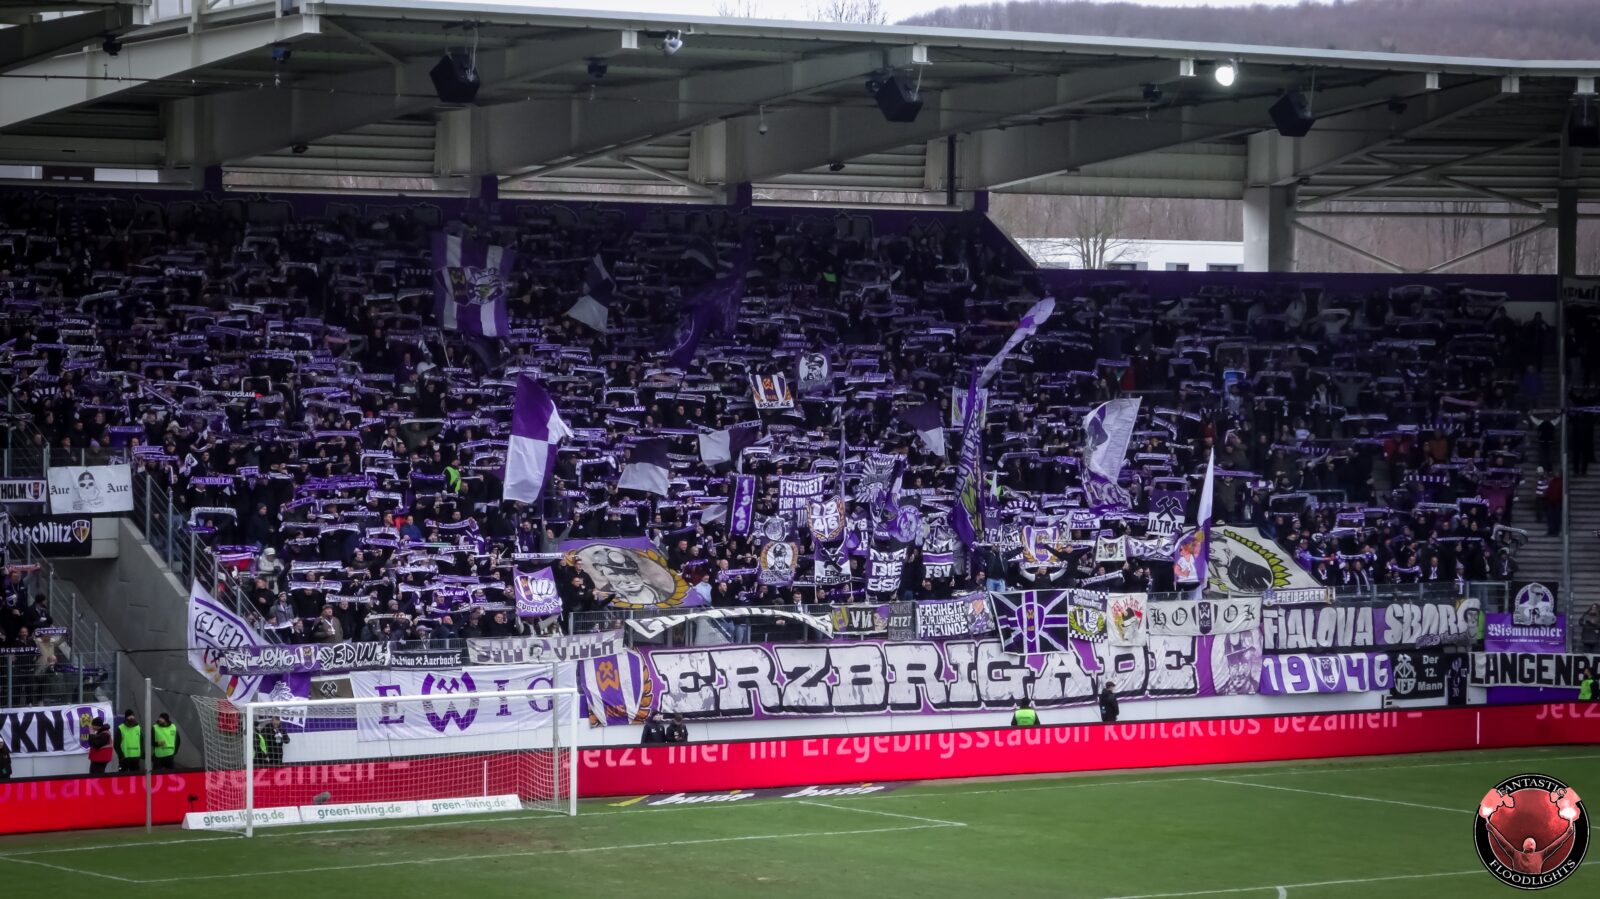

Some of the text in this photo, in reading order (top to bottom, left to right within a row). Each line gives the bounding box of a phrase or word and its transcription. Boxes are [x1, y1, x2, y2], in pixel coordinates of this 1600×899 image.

[50, 485, 70, 495] Aue
[106, 483, 129, 493] Aue
[925, 565, 952, 578] FSV
[919, 601, 965, 616] FREIHEIT
[889, 616, 911, 627] JETZT
[920, 621, 968, 637] FREUNDE
[1487, 624, 1562, 637] Wismutadler
[1422, 655, 1439, 665] Der
[650, 637, 1197, 718] ERZBRIGADE
[1425, 667, 1438, 677] 12.
[1417, 681, 1443, 691] Mann
[317, 804, 402, 819] green-living.de
[432, 799, 506, 812] green-living.de
[203, 810, 284, 827] green-liing.de
